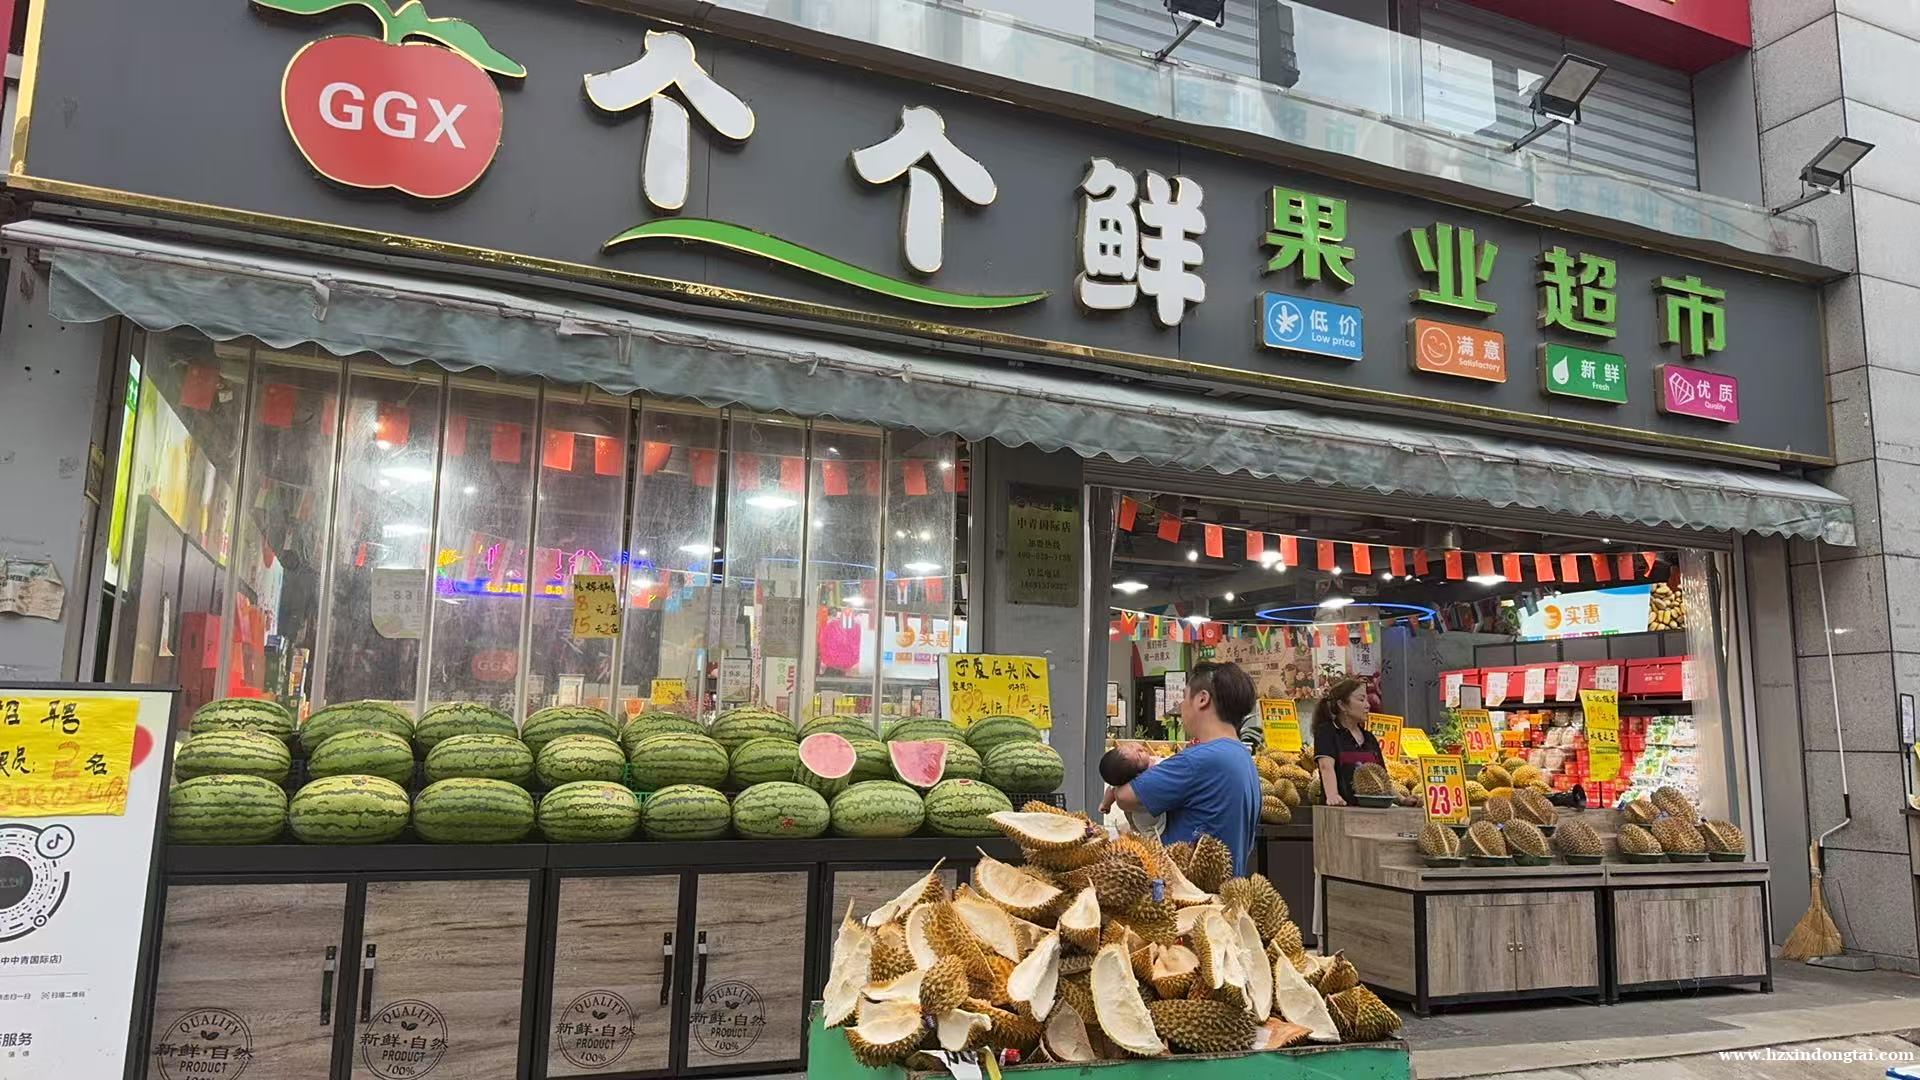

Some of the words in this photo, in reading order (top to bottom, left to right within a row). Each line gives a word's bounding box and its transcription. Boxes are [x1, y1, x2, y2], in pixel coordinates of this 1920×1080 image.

[318, 81, 468, 149] GGX
[583, 28, 1207, 327] 个个鲜
[1260, 186, 1728, 358] 果业超市
[1309, 309, 1358, 338] 低价
[1311, 331, 1331, 346] Low
[1332, 335, 1356, 348] price
[1457, 335, 1501, 361] 满意
[1458, 358, 1501, 373] Satisfactory
[1580, 359, 1621, 384] 新鲜
[1592, 381, 1611, 392] Fresh
[1696, 380, 1734, 404] 优质
[1704, 401, 1727, 413] Quality
[1565, 603, 1601, 625] 实惠
[1466, 731, 1492, 751] 29.8
[1428, 786, 1463, 815] 23.8
[574, 996, 626, 1015] QUALITY
[708, 986, 756, 1006] QUALITY
[179, 1014, 242, 1036] QUALITY
[382, 1006, 440, 1027] QUALITY
[710, 1026, 748, 1038] PRODUCT
[575, 1038, 617, 1050] PRODUCT
[713, 1039, 740, 1051] 100%
[382, 1050, 427, 1062] PRODUCT
[580, 1051, 607, 1063] 100%
[179, 1061, 228, 1074] PRODUCT
[386, 1064, 416, 1077] 100%
